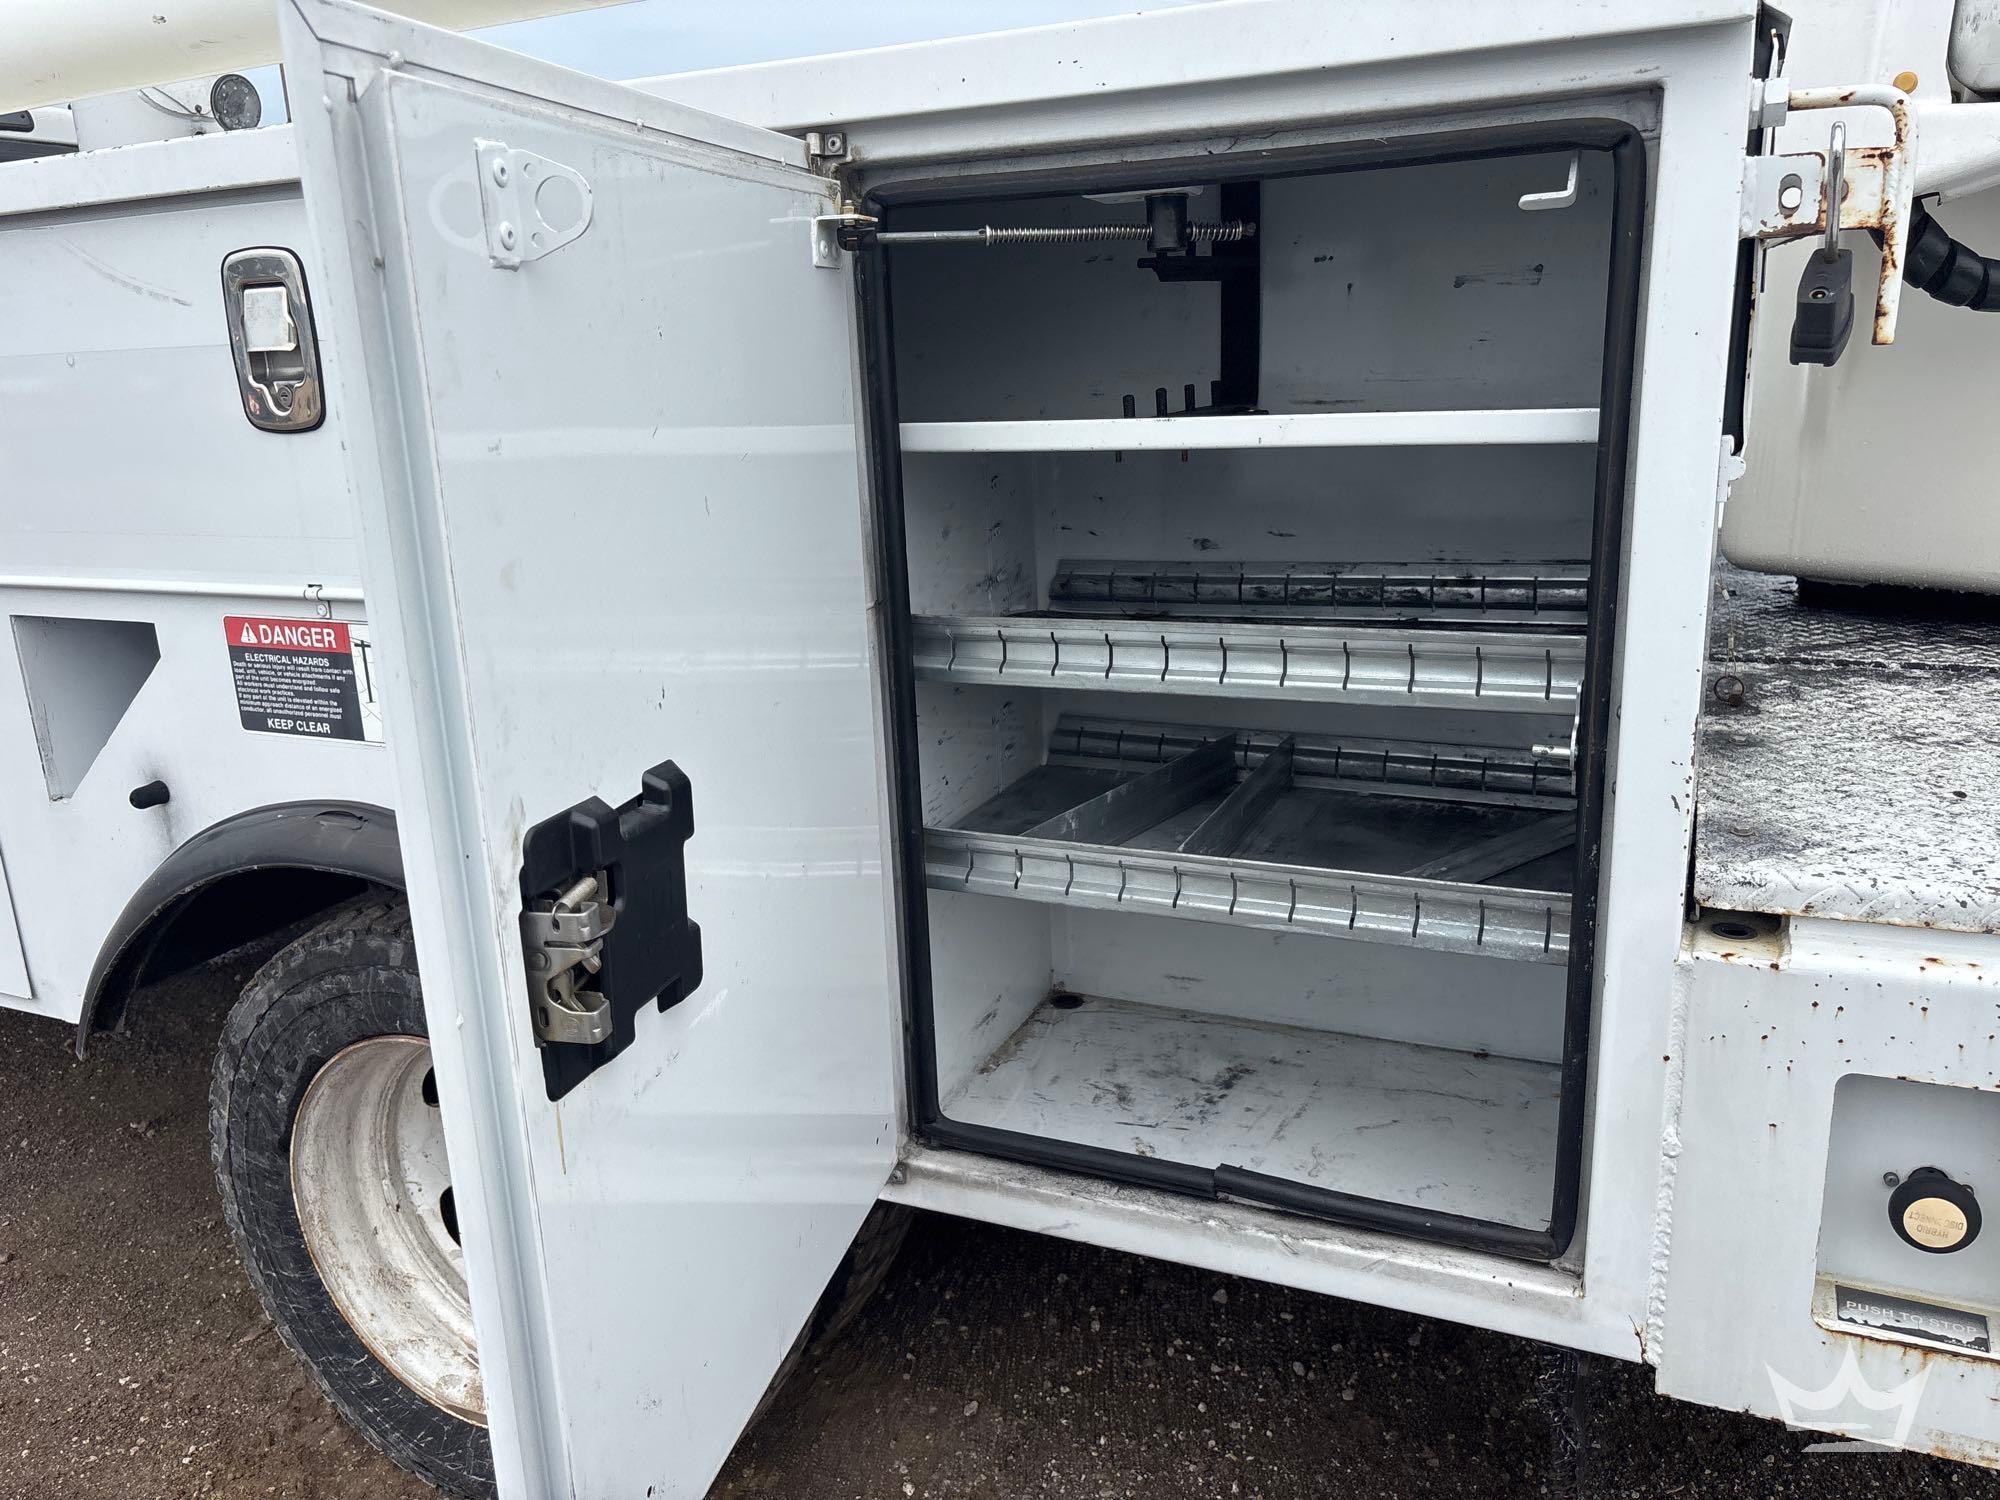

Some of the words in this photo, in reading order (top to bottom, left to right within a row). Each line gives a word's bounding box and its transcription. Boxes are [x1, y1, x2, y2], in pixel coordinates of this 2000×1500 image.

[258, 624, 337, 648] DANGER
[245, 652, 291, 664] ELECTRICAL
[292, 656, 330, 667] HAZARDS
[267, 718, 294, 730] KEEP
[296, 720, 331, 734] CLEAR
[1916, 1224, 1950, 1239] HYBRID
[1846, 1300, 1894, 1318] PUSH
[1899, 1312, 1923, 1325] TO
[1929, 1317, 1977, 1334] STOP
